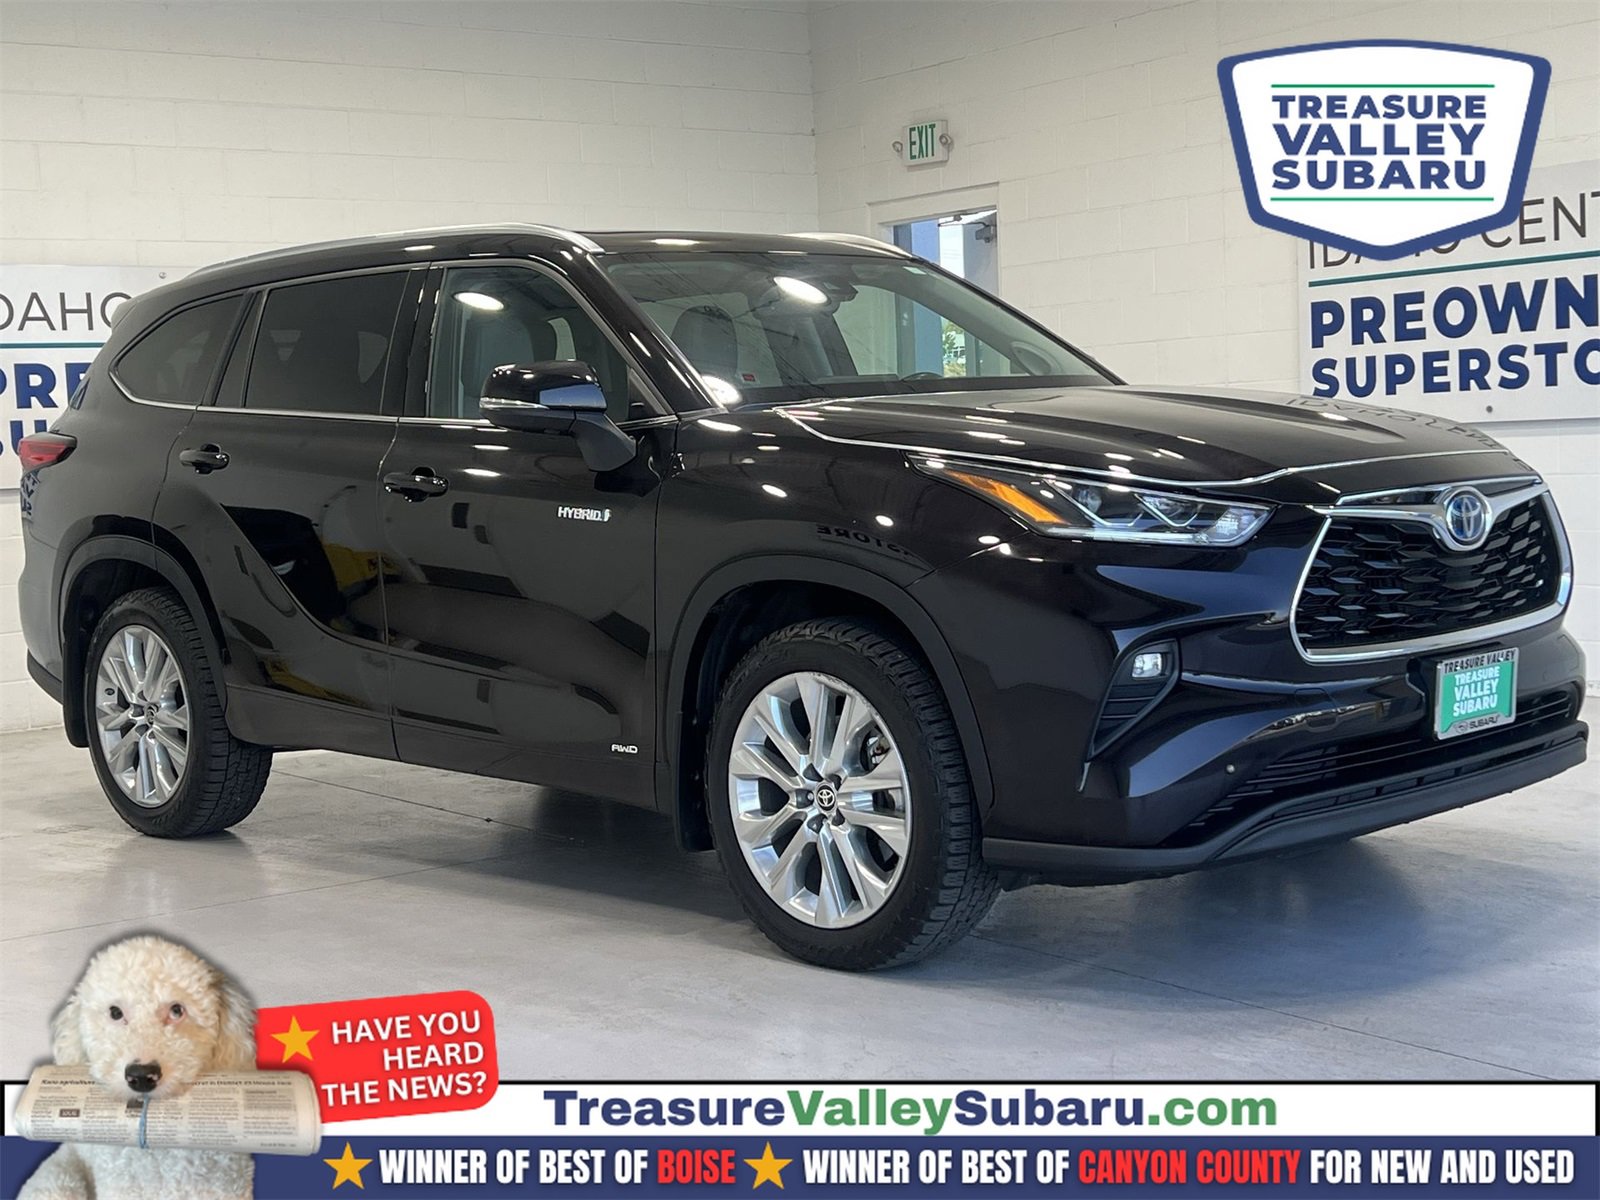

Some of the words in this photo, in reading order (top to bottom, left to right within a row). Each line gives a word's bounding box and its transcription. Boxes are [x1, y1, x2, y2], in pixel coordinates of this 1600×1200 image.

[908, 123, 936, 160] EXIT
[1310, 273, 1599, 349] PREOWN
[557, 506, 603, 521] HYBRID
[1444, 656, 1485, 674] TREASURE
[1486, 649, 1517, 665] VALLEY
[1454, 666, 1500, 686] TREASURE
[1453, 678, 1499, 701] VALLEY
[1452, 694, 1498, 717] SUBARU
[1469, 715, 1499, 729] SUBARU
[611, 743, 638, 754] AWD
